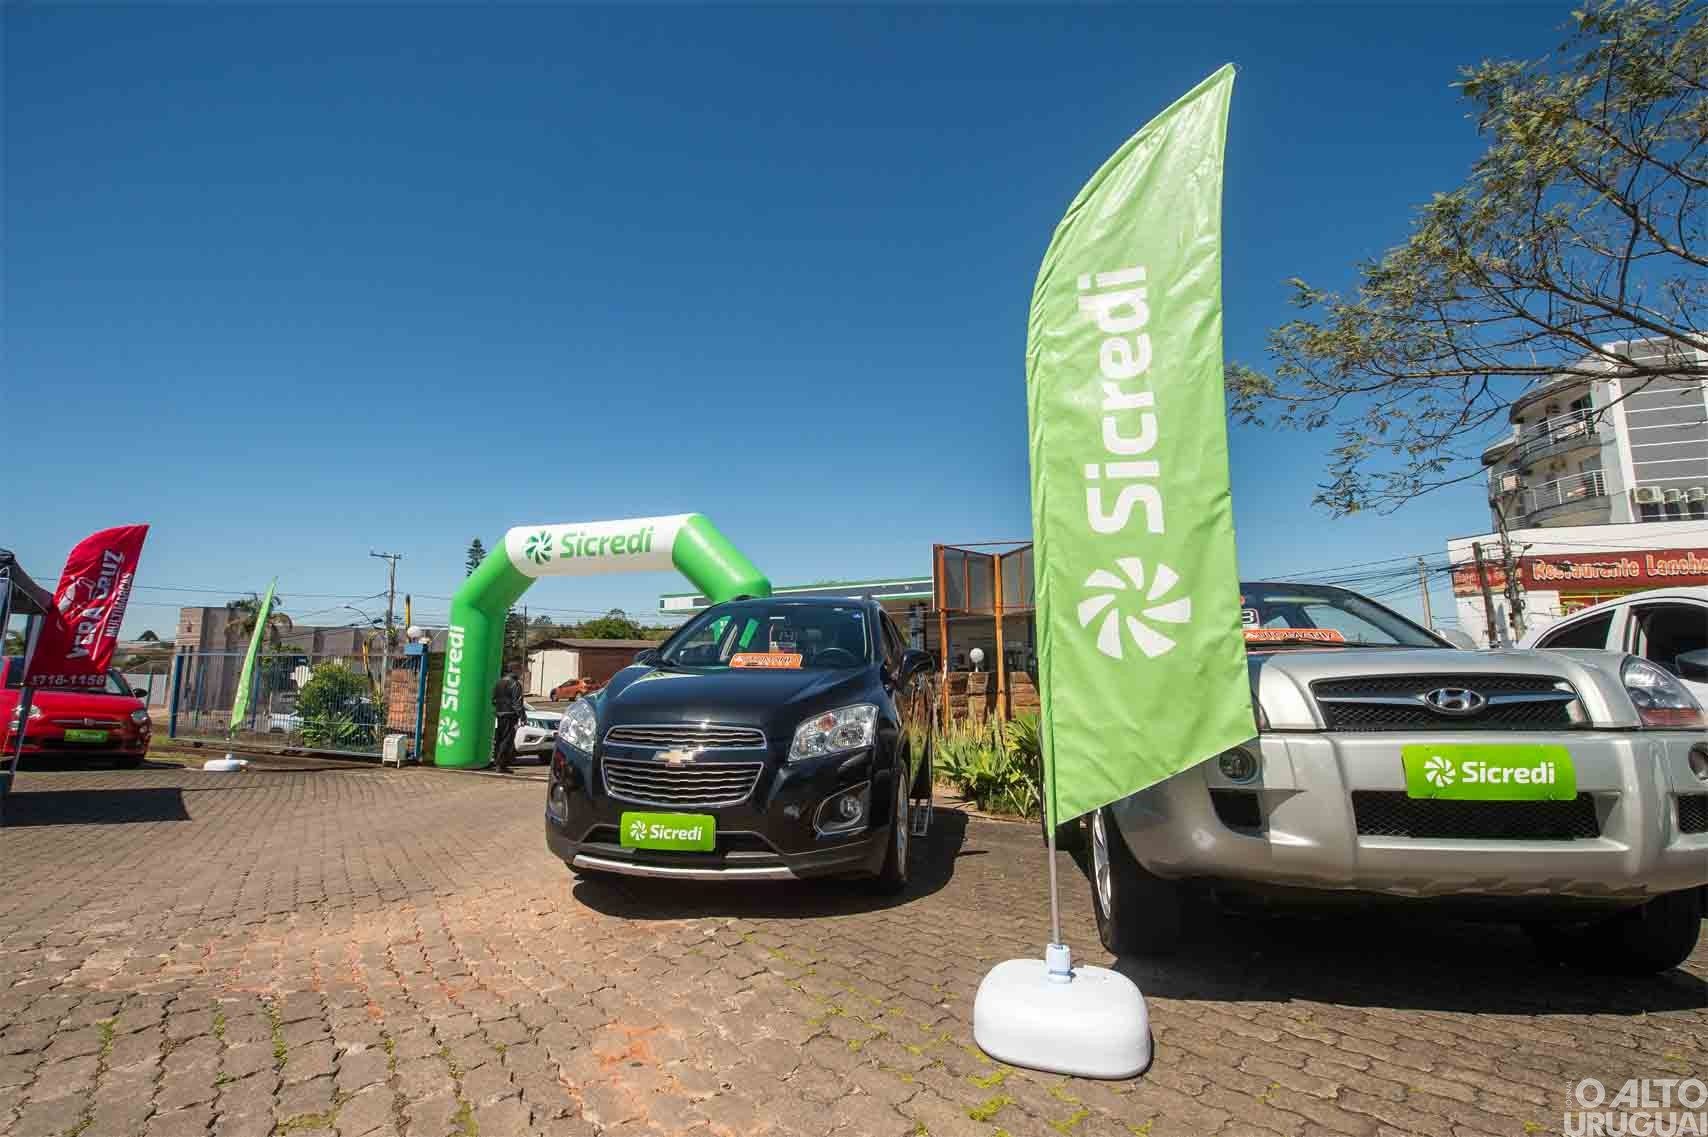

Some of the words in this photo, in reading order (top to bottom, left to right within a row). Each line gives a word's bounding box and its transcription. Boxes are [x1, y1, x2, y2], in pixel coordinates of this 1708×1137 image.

[1077, 265, 1164, 534] Sicredi
[560, 527, 654, 558] Sicredi
[441, 625, 465, 712] Sicredi
[1461, 761, 1555, 785] Sicredi
[649, 823, 703, 841] Sicredi
